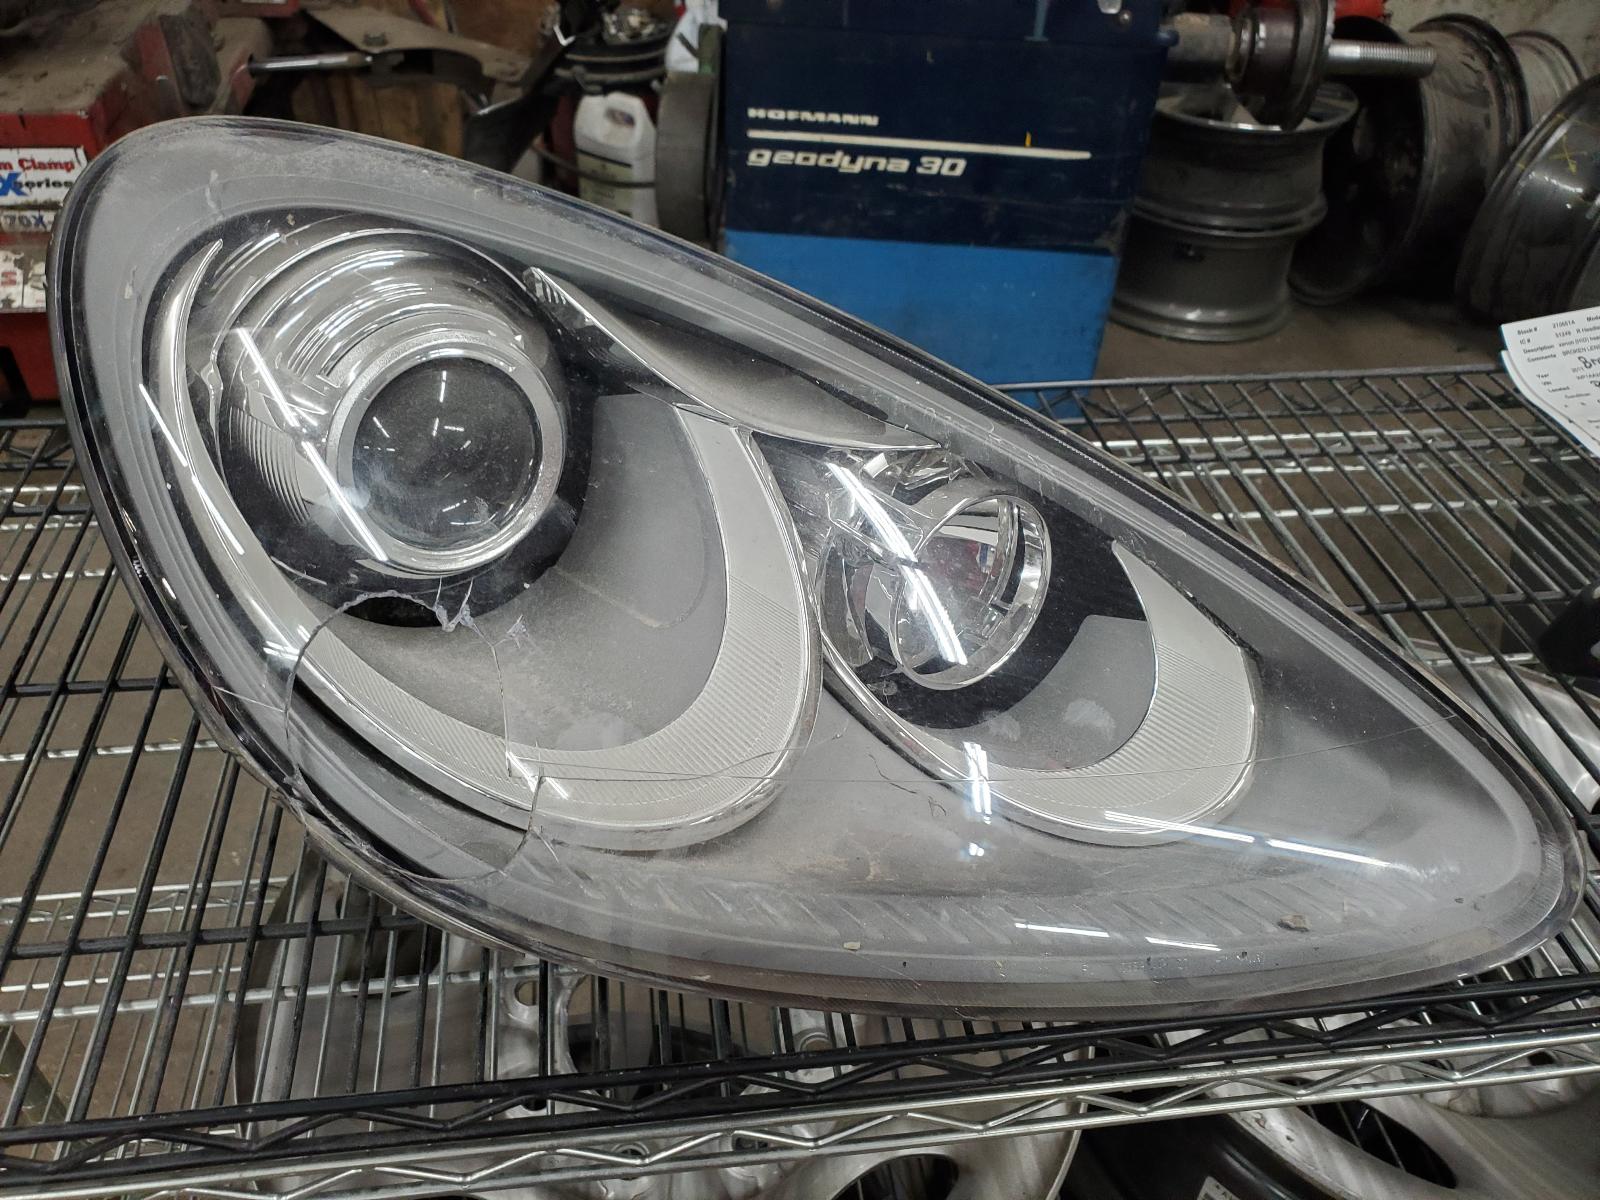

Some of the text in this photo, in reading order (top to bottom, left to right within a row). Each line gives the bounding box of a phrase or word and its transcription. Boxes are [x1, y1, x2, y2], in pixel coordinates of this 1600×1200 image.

[748, 108, 879, 126] HOFMANN
[18, 158, 75, 172] Clamp
[747, 148, 967, 177] geodyna 30
